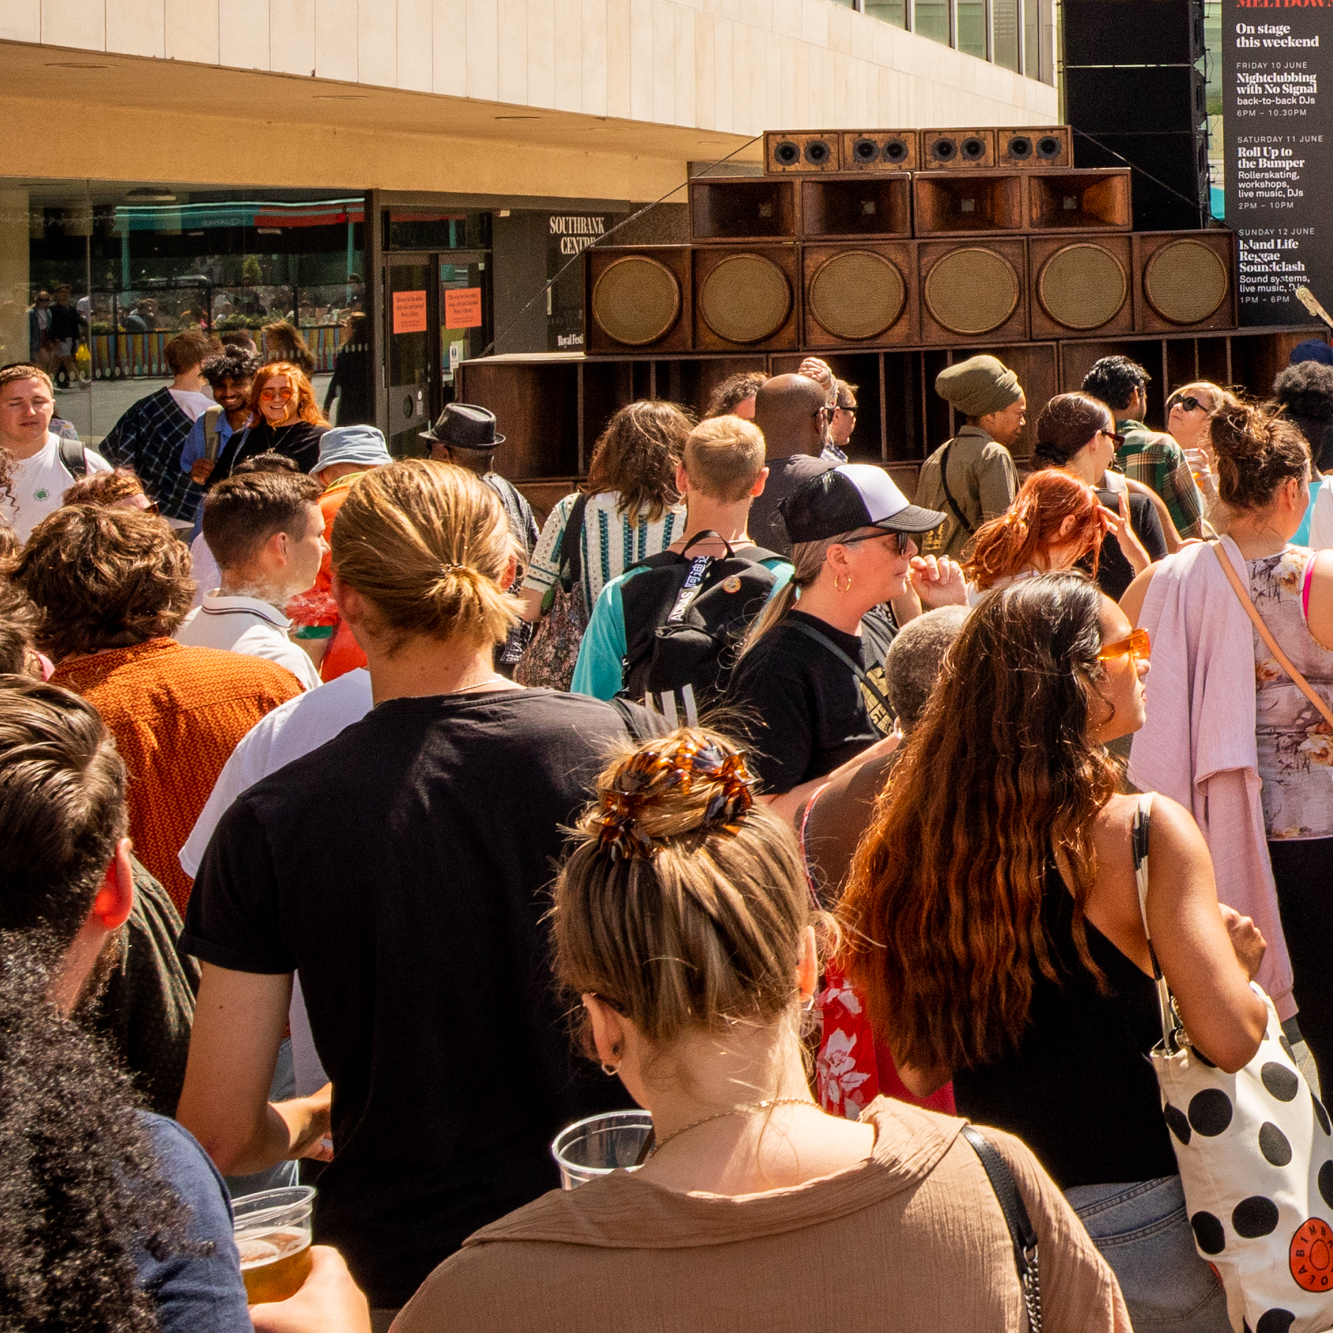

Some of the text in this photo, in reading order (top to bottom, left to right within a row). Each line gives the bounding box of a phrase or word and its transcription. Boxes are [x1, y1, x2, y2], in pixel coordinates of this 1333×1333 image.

[1236, 23, 1291, 38] On stage
[1236, 35, 1319, 47] this weekend
[1237, 72, 1317, 86] Nightclubbing
[1237, 82, 1317, 98] with No Signal
[1237, 96, 1315, 105] back-to-back DJs
[1238, 147, 1292, 160] Roll Up to
[1238, 157, 1305, 171] the Bumper
[1239, 170, 1300, 181] Rollerskating,
[1238, 179, 1290, 190] workshops,
[1239, 188, 1303, 198] live music, DJs
[549, 216, 605, 234] SOUTHBANK
[1277, 239, 1299, 249] Life
[1240, 250, 1280, 264] Reggae
[1239, 260, 1305, 272] Soundclash
[1240, 275, 1270, 283] Sound
[1258, 284, 1287, 293] music,
[558, 334, 573, 348] Royal
